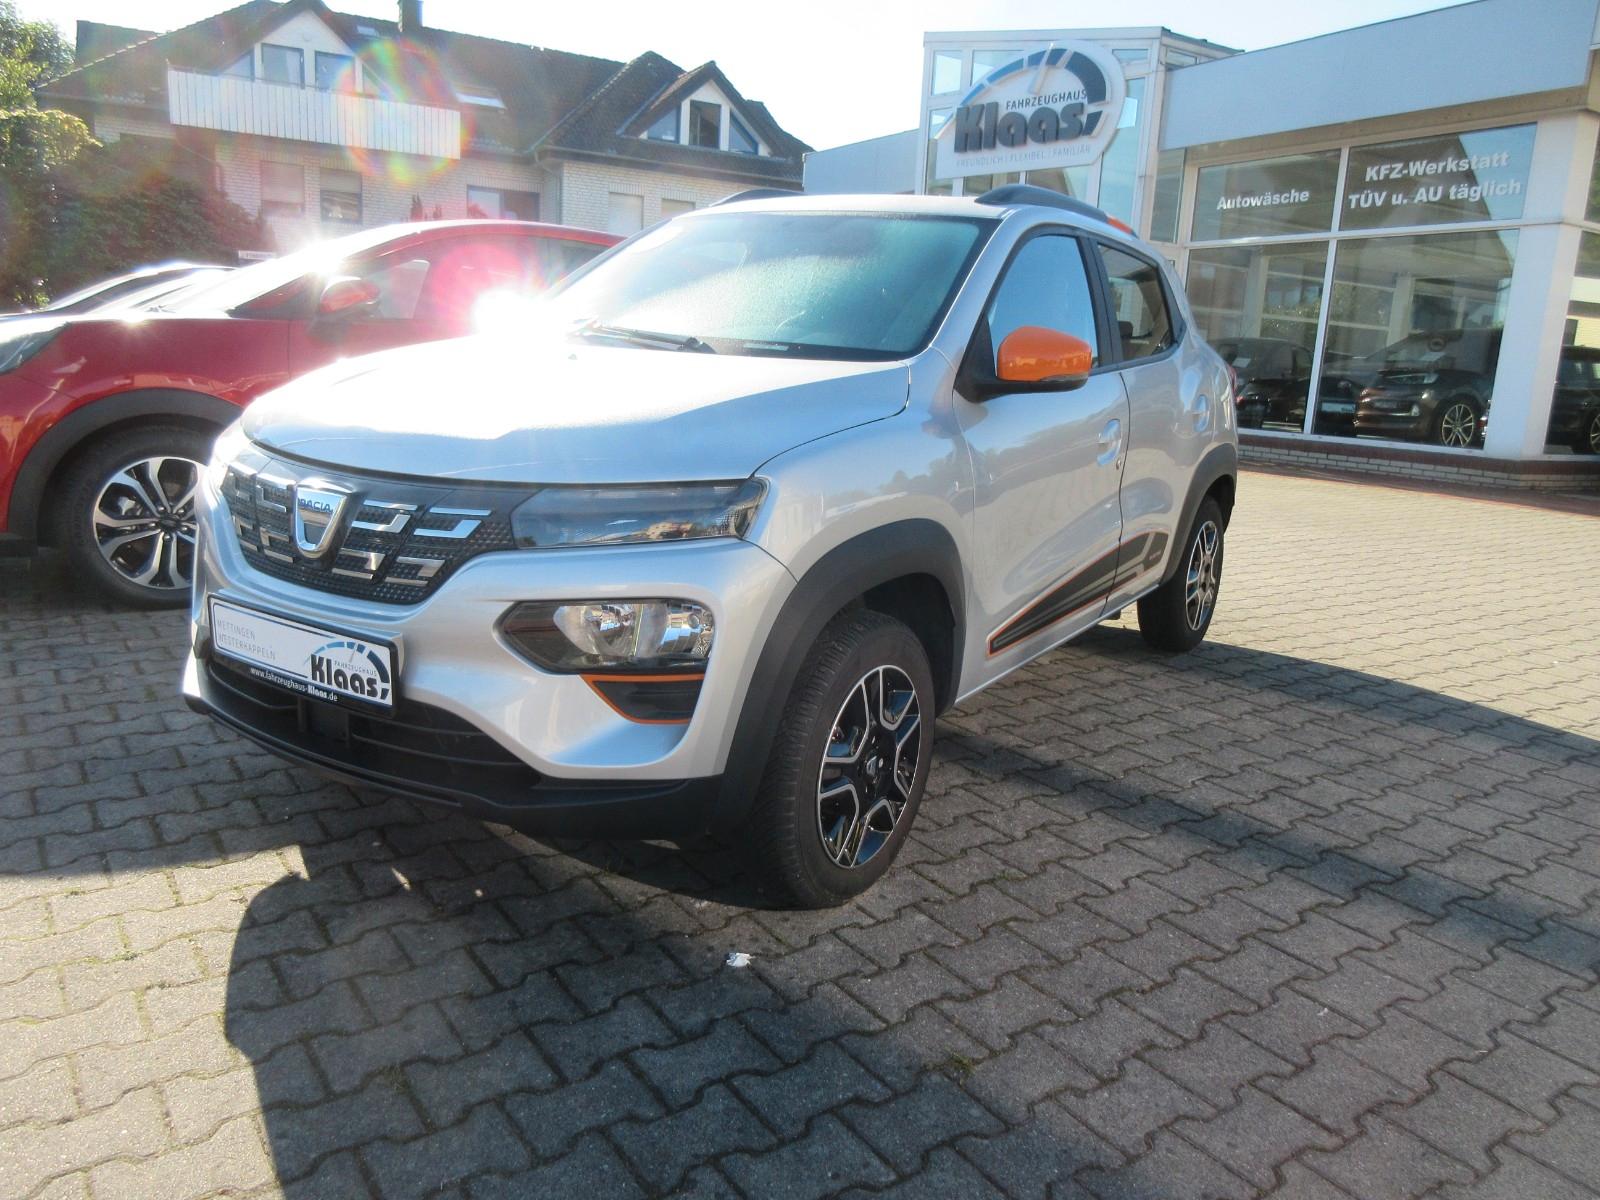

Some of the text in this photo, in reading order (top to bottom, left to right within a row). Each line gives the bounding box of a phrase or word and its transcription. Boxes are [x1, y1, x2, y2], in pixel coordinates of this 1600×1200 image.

[1006, 90, 1087, 110] FAHRZEUGHAUS
[954, 101, 1084, 153] Klaas
[1365, 152, 1510, 182] KFZ-Werkstatt
[1216, 189, 1309, 211] Autowäsche
[1349, 179, 1521, 209] TÜV u. AU täglich
[299, 498, 331, 513] DACIA
[311, 653, 379, 698] Klaas
[334, 660, 377, 677] FAHRZEUGHAUS
